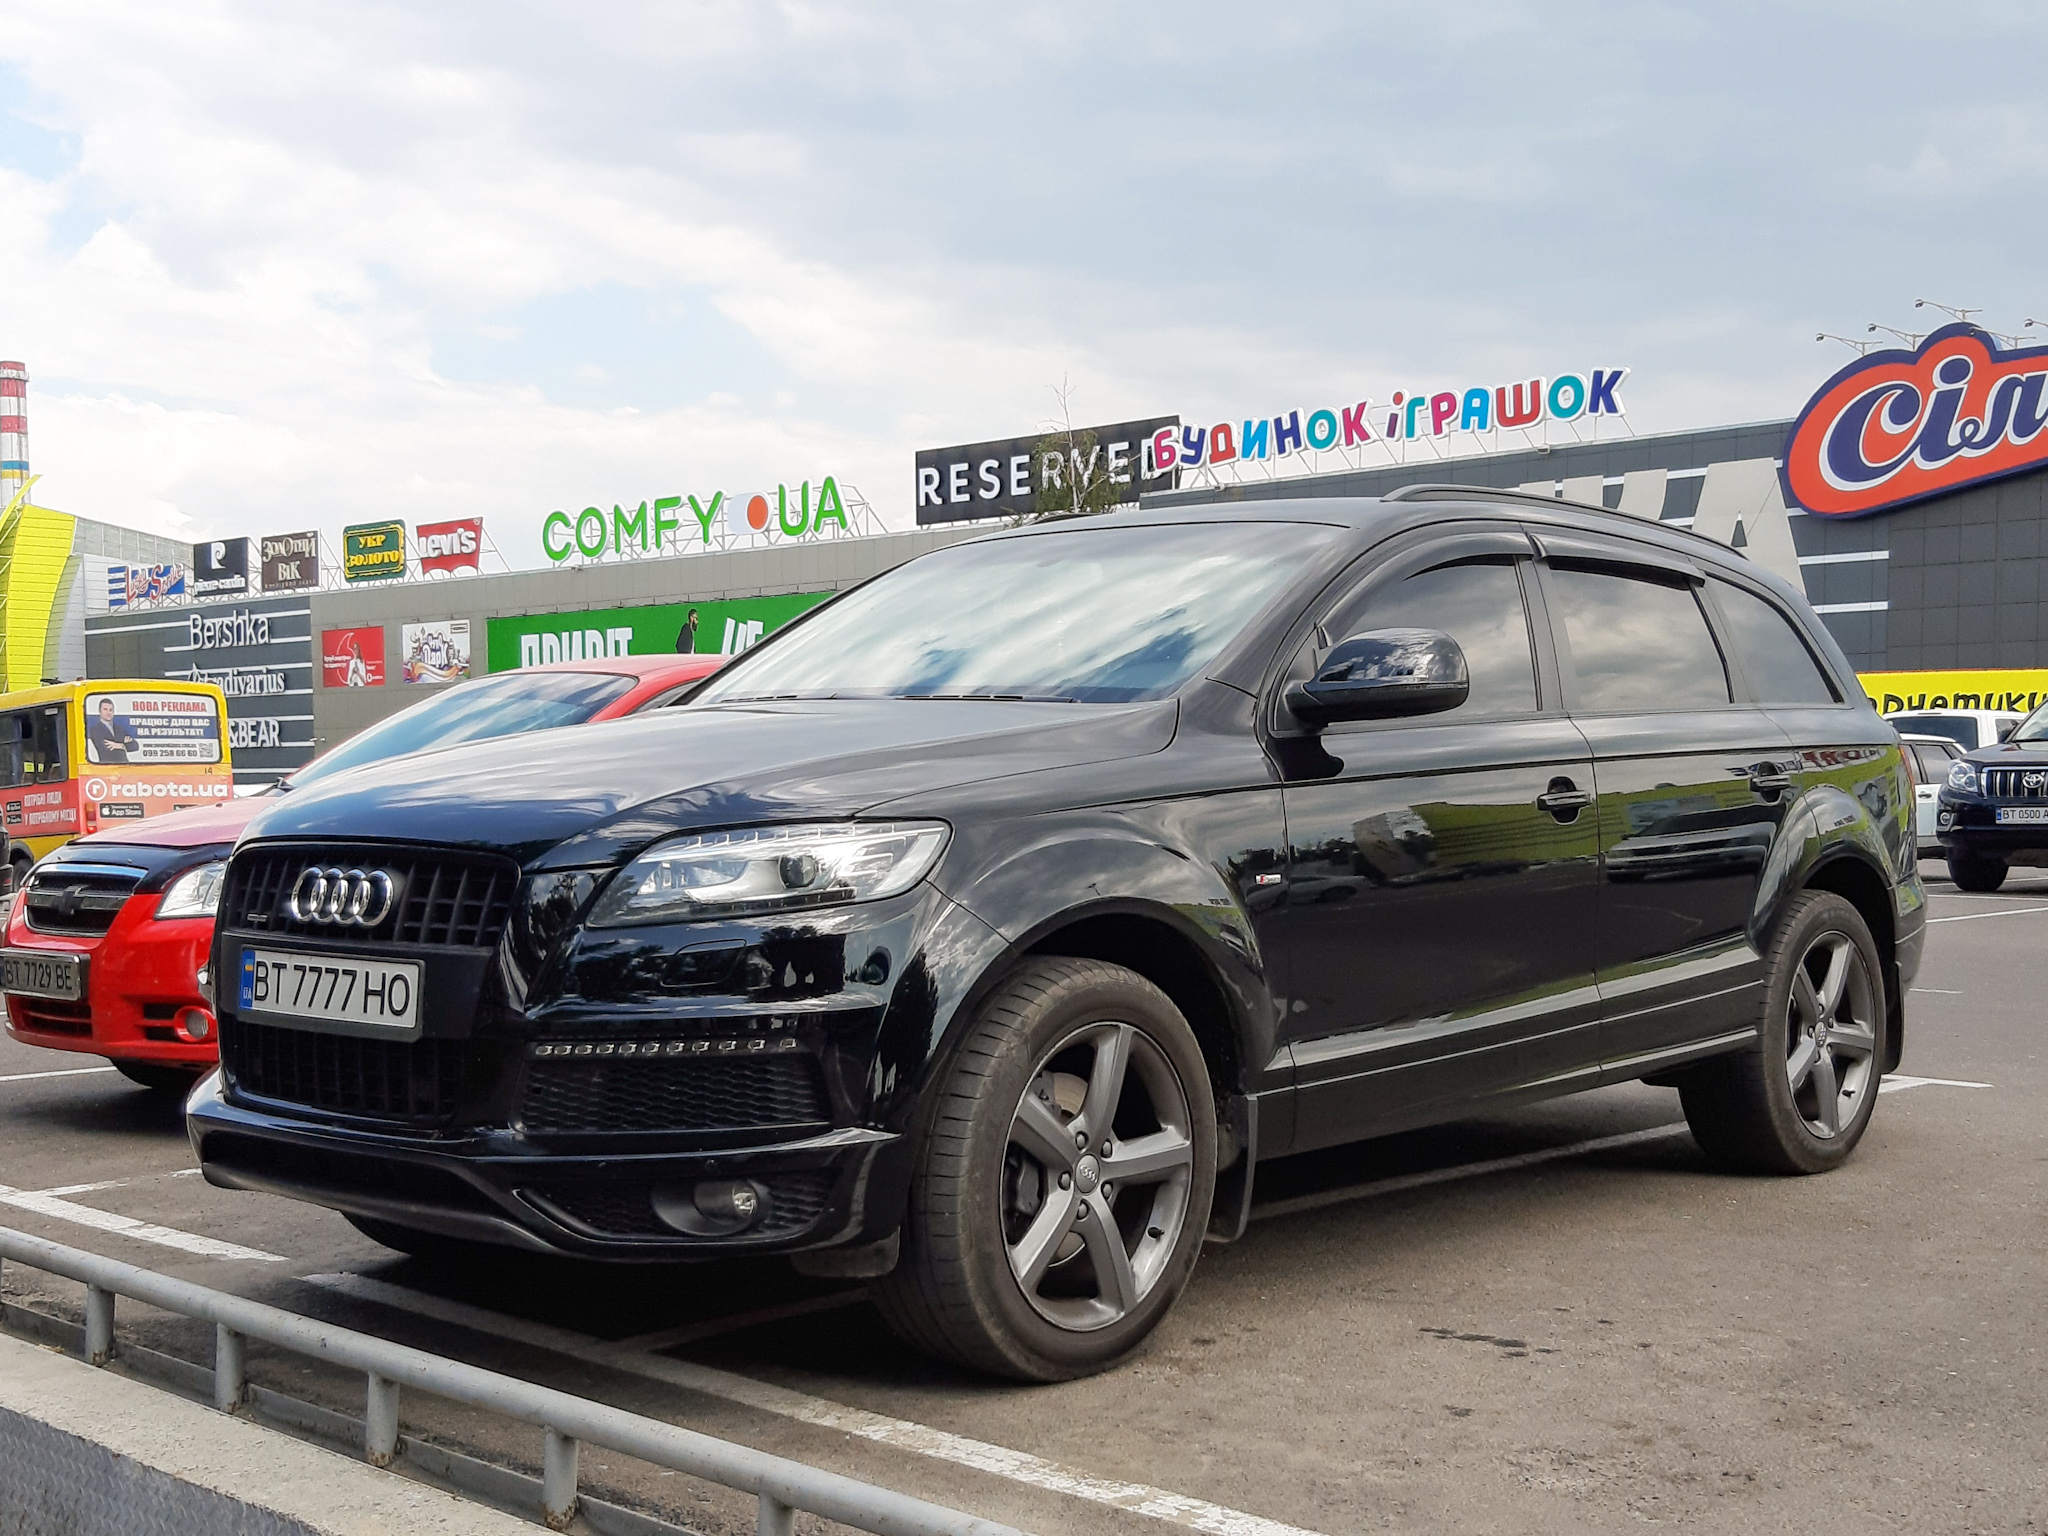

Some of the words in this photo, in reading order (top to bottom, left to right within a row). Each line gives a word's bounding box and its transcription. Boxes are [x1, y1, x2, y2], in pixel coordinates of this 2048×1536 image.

[1154, 401, 1372, 470] БУДИНОК
[543, 490, 727, 562] COMFY
[778, 475, 848, 537] UA
[358, 534, 387, 549] УКР
[348, 550, 401, 567] ЗОЛОТО
[190, 609, 269, 650] Bershka
[132, 701, 159, 712] НОВА
[161, 701, 207, 712] РЕКЛАМА
[111, 781, 228, 797] rabota.ua
[2002, 809, 2016, 820] BT
[2018, 809, 2040, 820] 0500
[24, 961, 52, 988] 7729
[56, 964, 73, 990] BE
[254, 960, 288, 1004] BT
[292, 964, 358, 1012] 7777
[363, 971, 410, 1016] HO
